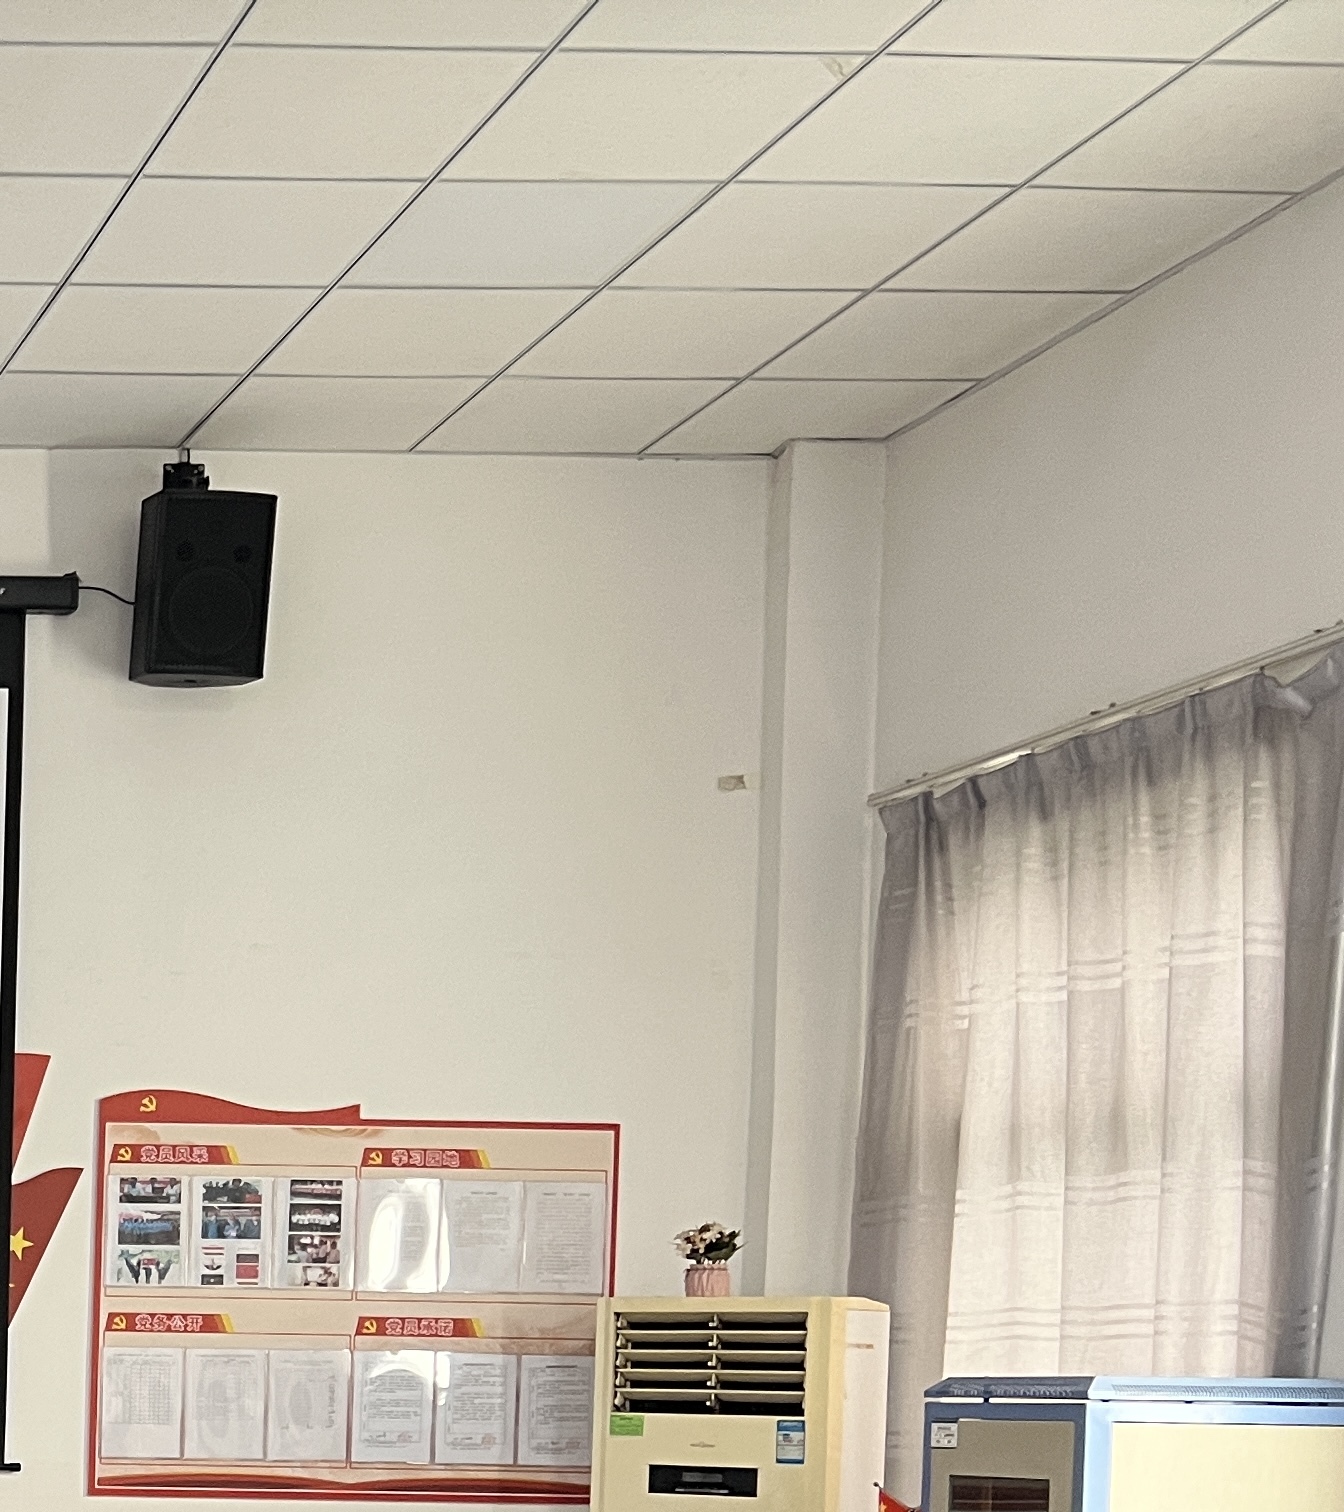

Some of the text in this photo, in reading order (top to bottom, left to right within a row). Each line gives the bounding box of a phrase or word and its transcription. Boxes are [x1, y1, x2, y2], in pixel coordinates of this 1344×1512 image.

[140, 1145, 459, 1167] 党员风采 学习园地
[134, 1314, 454, 1335] 党务公开 党员承诺
